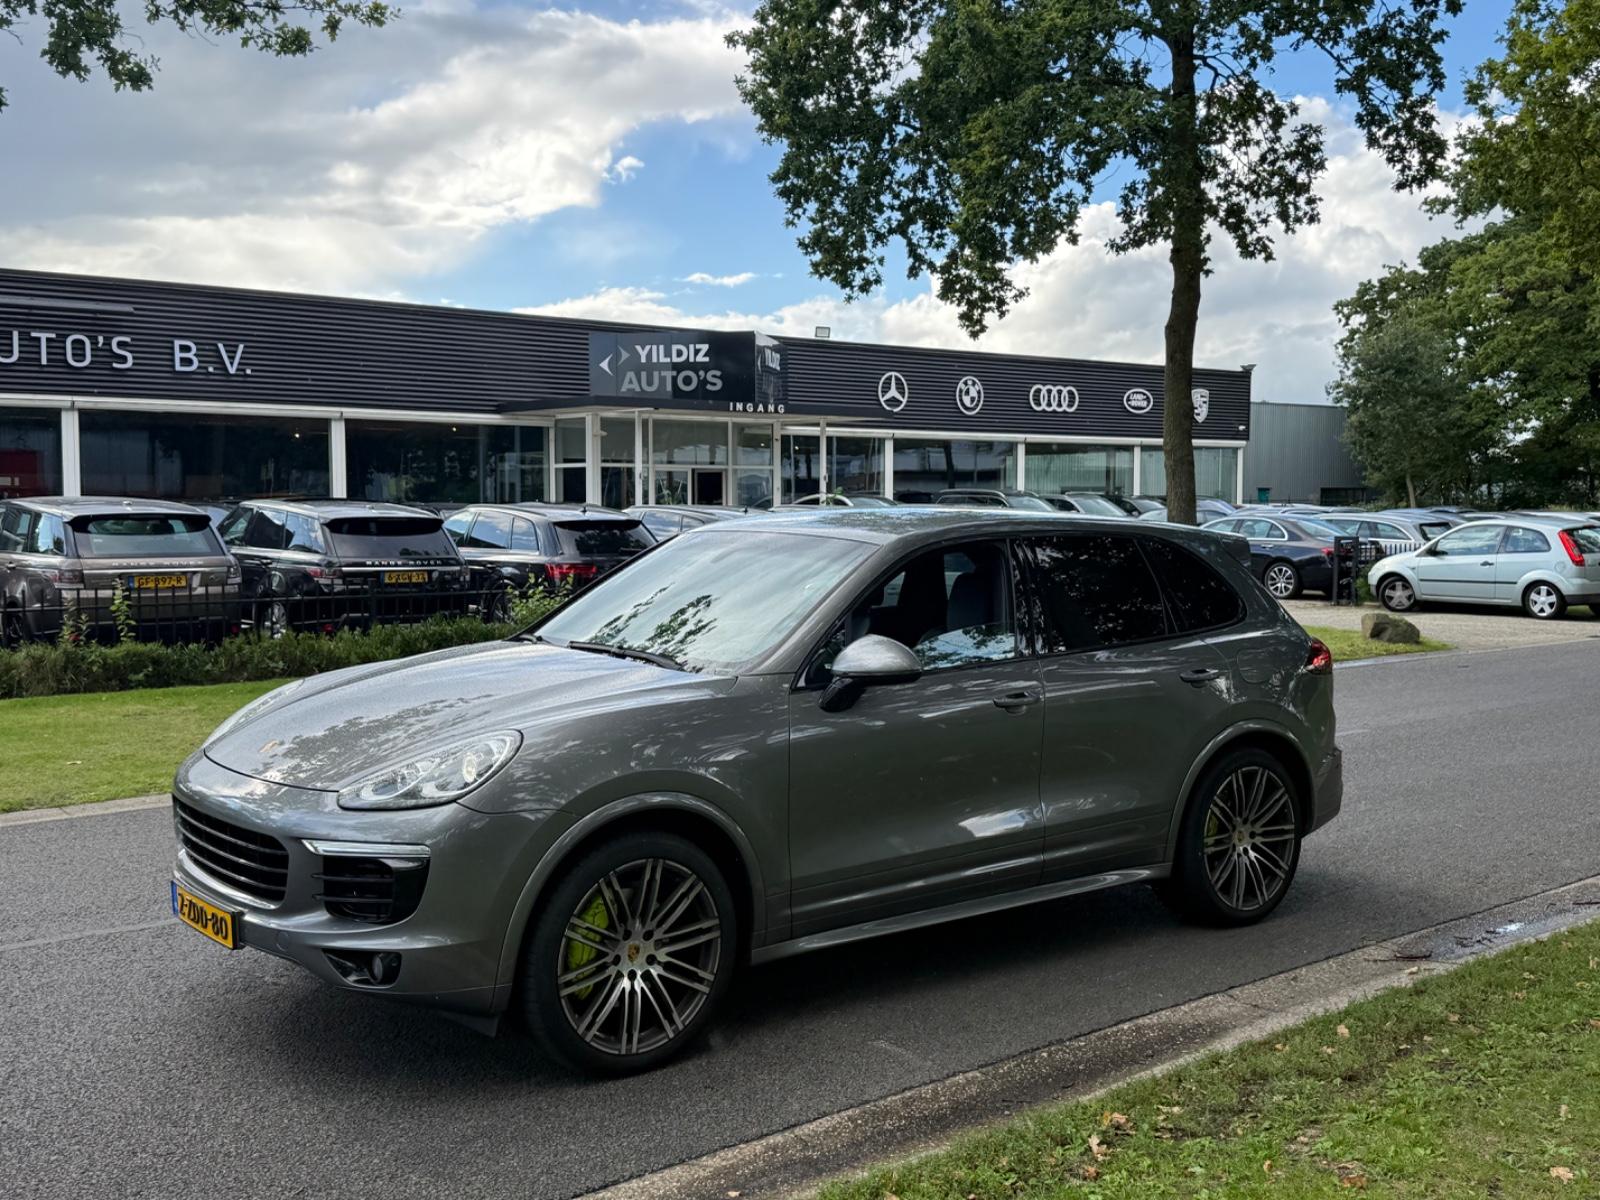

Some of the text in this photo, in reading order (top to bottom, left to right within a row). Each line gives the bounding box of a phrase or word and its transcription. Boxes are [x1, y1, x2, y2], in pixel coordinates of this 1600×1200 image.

[173, 339, 252, 375] B.V.
[635, 344, 710, 363] YILDIZ
[620, 370, 723, 393] AUTO'S
[729, 402, 785, 414] INGANG
